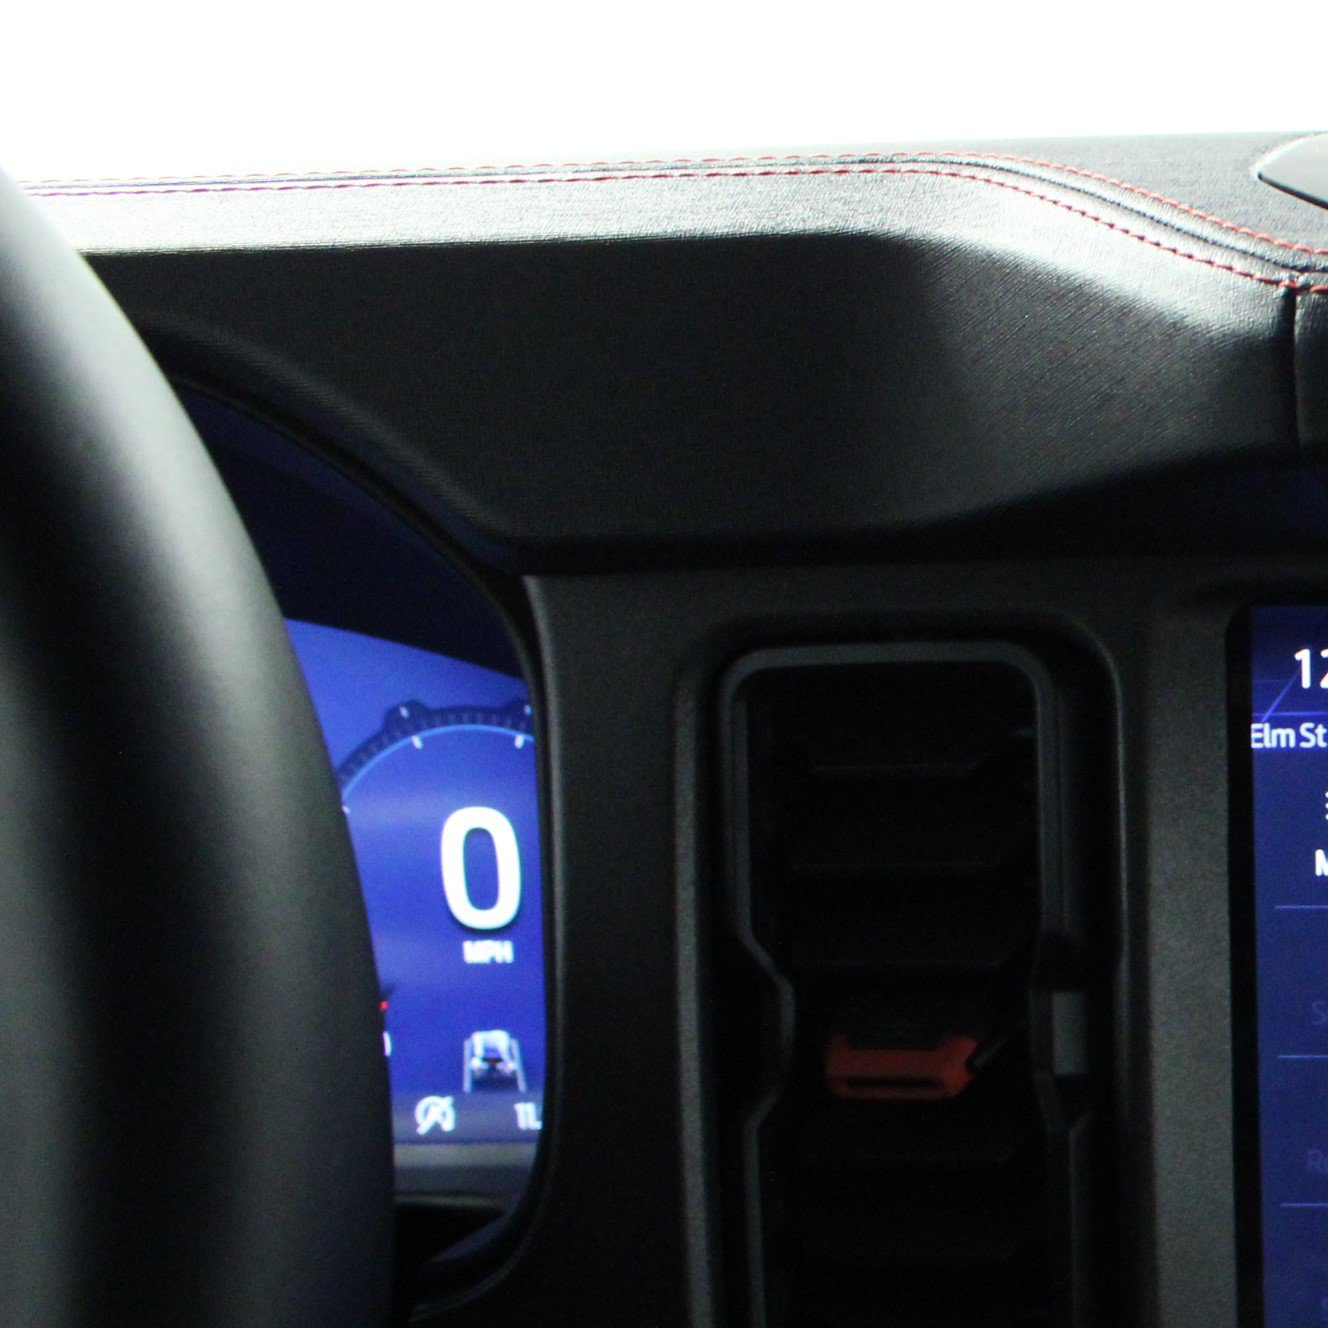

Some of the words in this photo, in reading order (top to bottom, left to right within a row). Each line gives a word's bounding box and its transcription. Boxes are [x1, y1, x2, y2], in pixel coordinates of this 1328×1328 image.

[1300, 722, 1328, 748] St
[440, 806, 521, 930] 0
[462, 939, 514, 964] MPH
